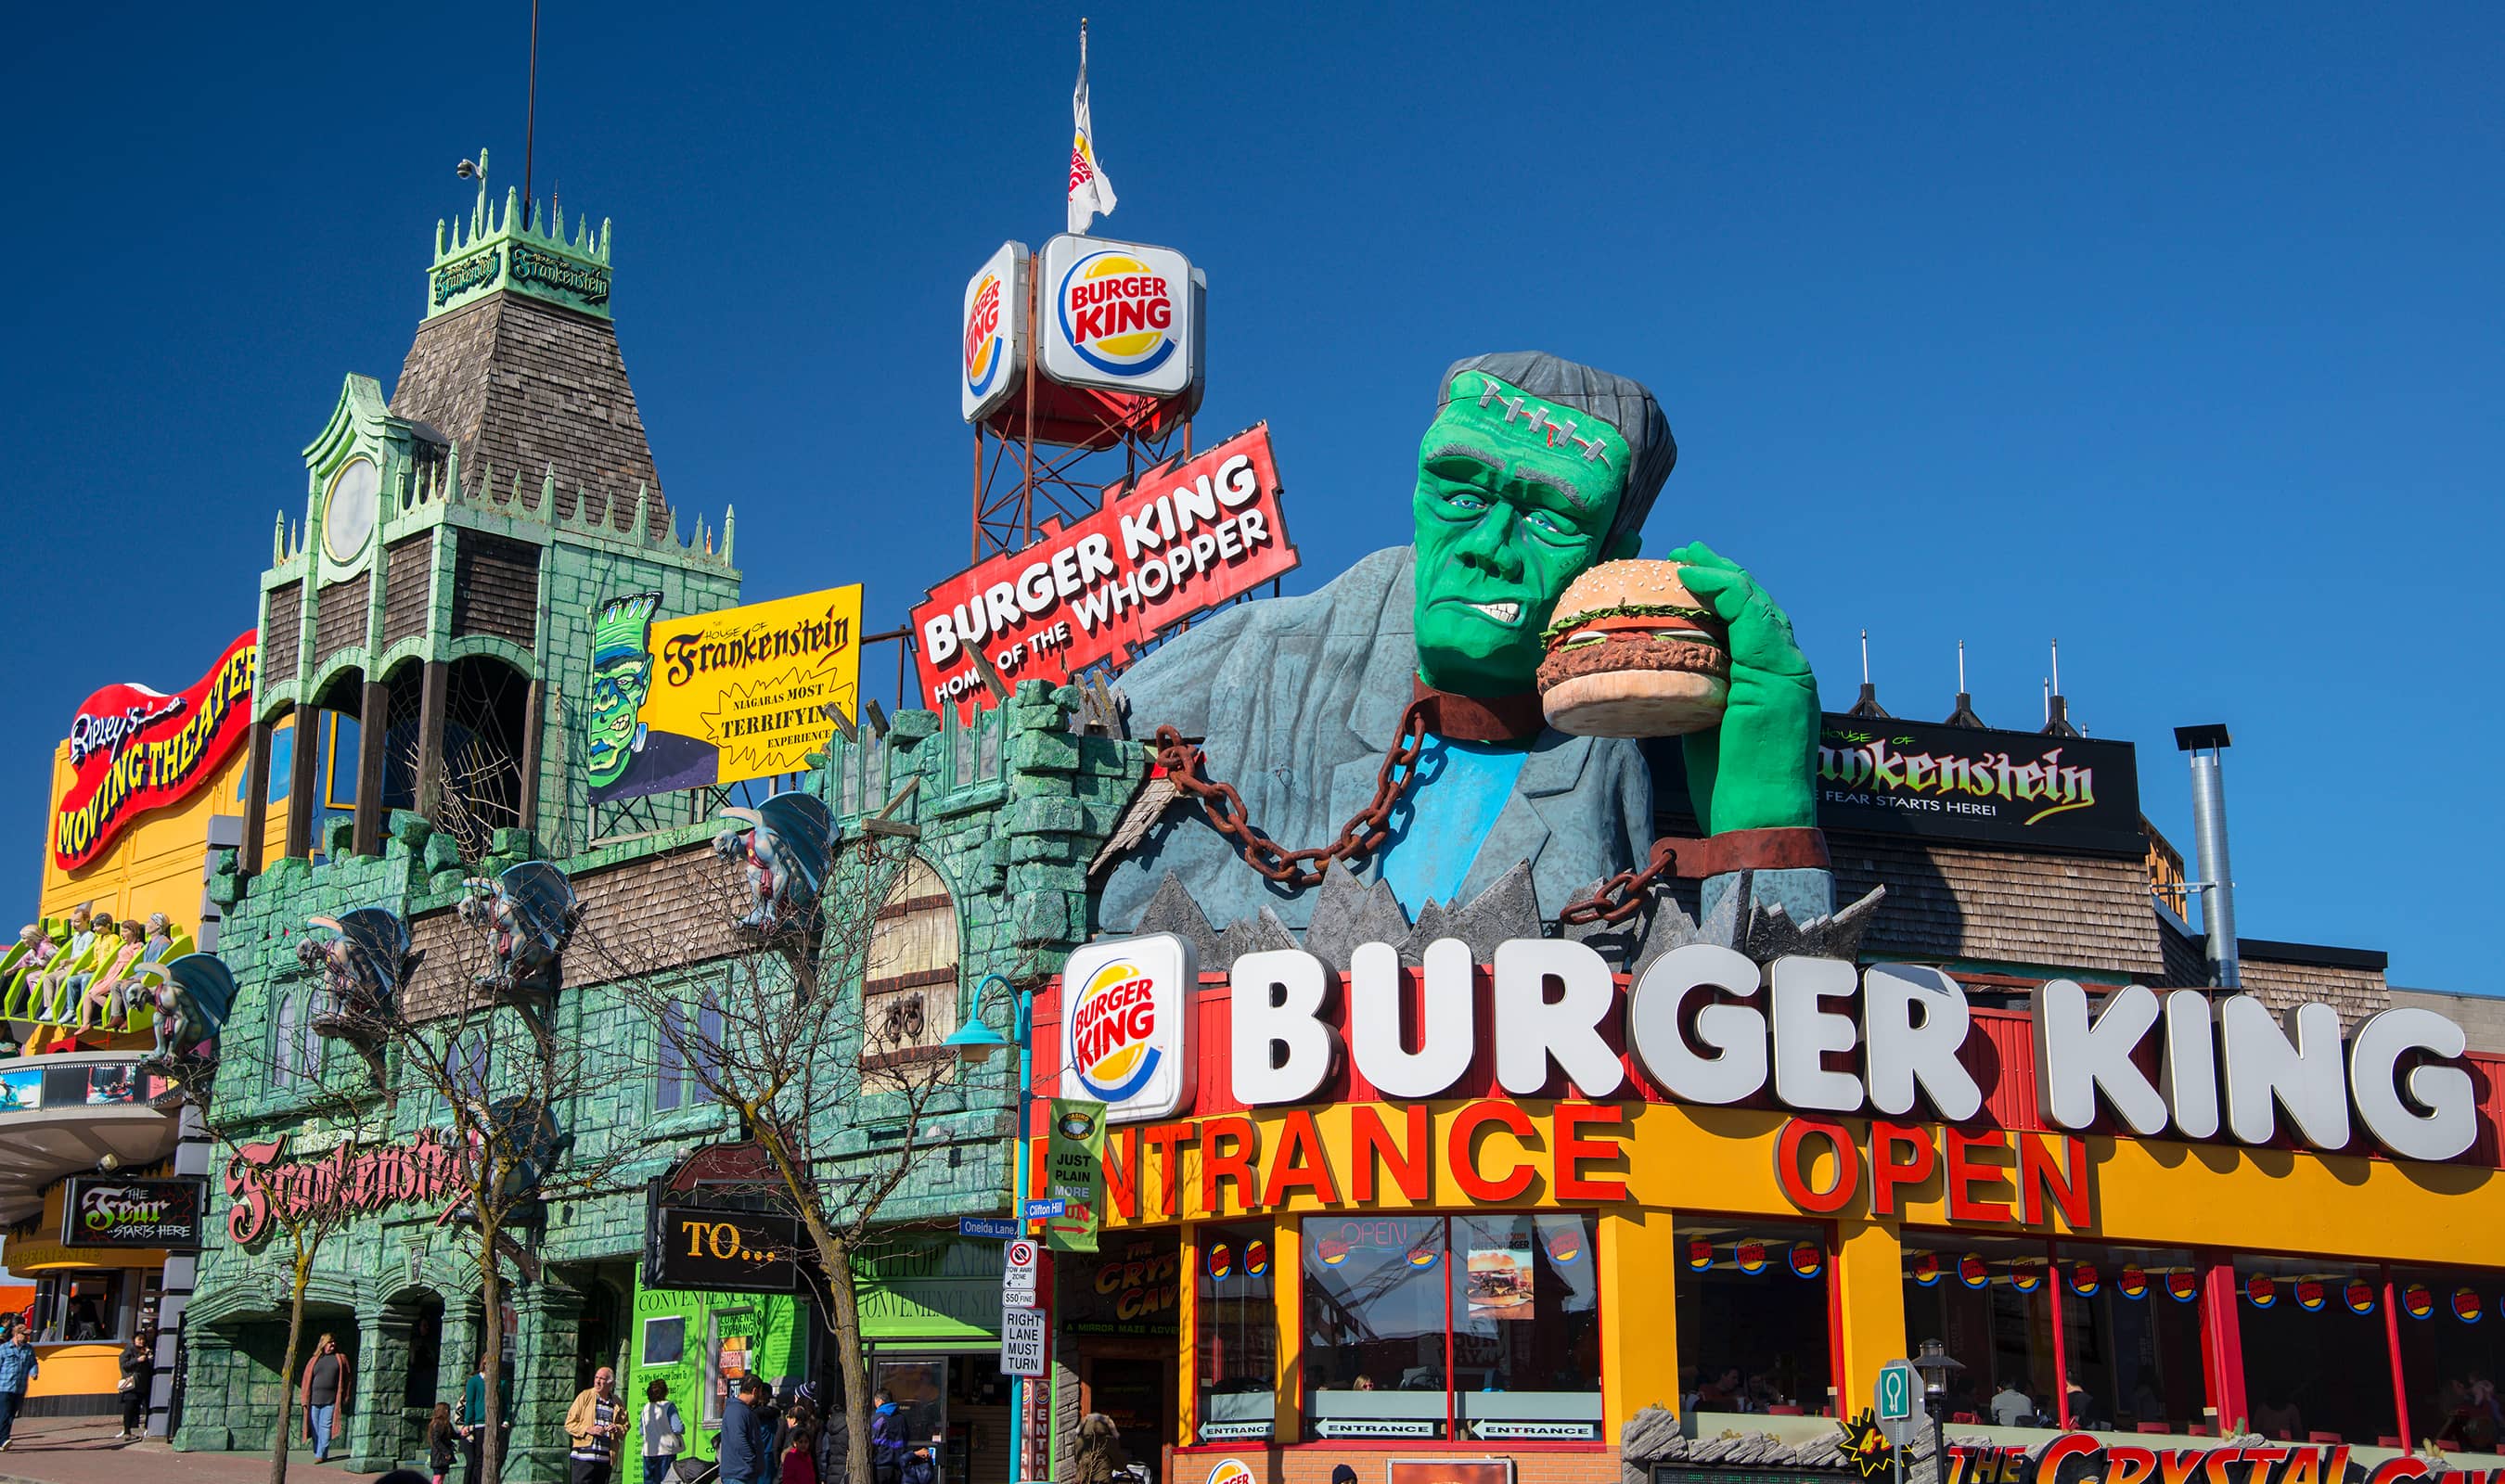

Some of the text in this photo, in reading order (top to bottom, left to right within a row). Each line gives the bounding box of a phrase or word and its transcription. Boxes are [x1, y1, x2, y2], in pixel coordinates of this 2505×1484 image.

[1072, 276, 1167, 312] BURGER
[1073, 299, 1172, 347] KING
[1120, 454, 1257, 560] KING
[924, 533, 1114, 665] BURGER
[934, 508, 1268, 704] HOM OF THE WHOPPER
[704, 621, 768, 641] HOUSE OF
[664, 604, 849, 687] Frankenstein
[733, 683, 825, 711] NIAGARAS MOST
[721, 701, 841, 739] TERRIFYIN
[767, 728, 831, 748] EXPERIENCE
[1821, 727, 1916, 746] HOUSE OF
[57, 645, 258, 854] MOVING THEATER
[1826, 790, 1870, 805] FEAR
[1876, 795, 1940, 812] STARTS
[1946, 801, 1997, 817] HERE!
[1075, 979, 1154, 1040] BURGER
[1076, 1002, 1155, 1077] KING
[1231, 937, 2478, 1161] BURGER KING
[1066, 1113, 1090, 1122] CASINO
[1057, 1154, 1091, 1168] JUST
[1055, 1170, 1090, 1183] PLAIN
[1774, 1117, 2092, 1229] OPEN
[125, 1186, 149, 1200] THE
[1054, 1185, 1090, 1198] MORE
[83, 1186, 172, 1232] Fear
[1029, 1201, 1062, 1217] Clifton Hill
[1065, 1201, 1092, 1222] UN
[156, 1224, 192, 1238] HERE
[965, 1221, 1015, 1235] Oneida Lane
[1341, 1222, 1407, 1245] OPEN
[682, 1222, 776, 1261] TO...
[854, 1245, 939, 1277] HILLTOP
[1095, 1253, 1178, 1295] CRYS
[971, 1290, 1004, 1317] STO
[1005, 1293, 1019, 1303] $50
[1116, 1285, 1178, 1321] CAV
[720, 1312, 754, 1324] CURRENC
[1008, 1313, 1041, 1327] RIGHT
[719, 1324, 753, 1336] EXCHANG
[1008, 1328, 1038, 1341] LANE
[1077, 1324, 1114, 1333] MIRROR
[1118, 1325, 1146, 1334] MAZE
[1150, 1325, 1179, 1335] ADVEN
[1008, 1343, 1039, 1355] MUST
[1008, 1357, 1038, 1370] TURN
[1206, 1425, 1273, 1436] ENTRANCE
[1328, 1424, 1430, 1434] ENTRANCE
[1485, 1426, 1589, 1436] ENTRANCE
[1035, 1409, 1047, 1480] ENTRA
[1947, 1445, 2028, 1484] THE
